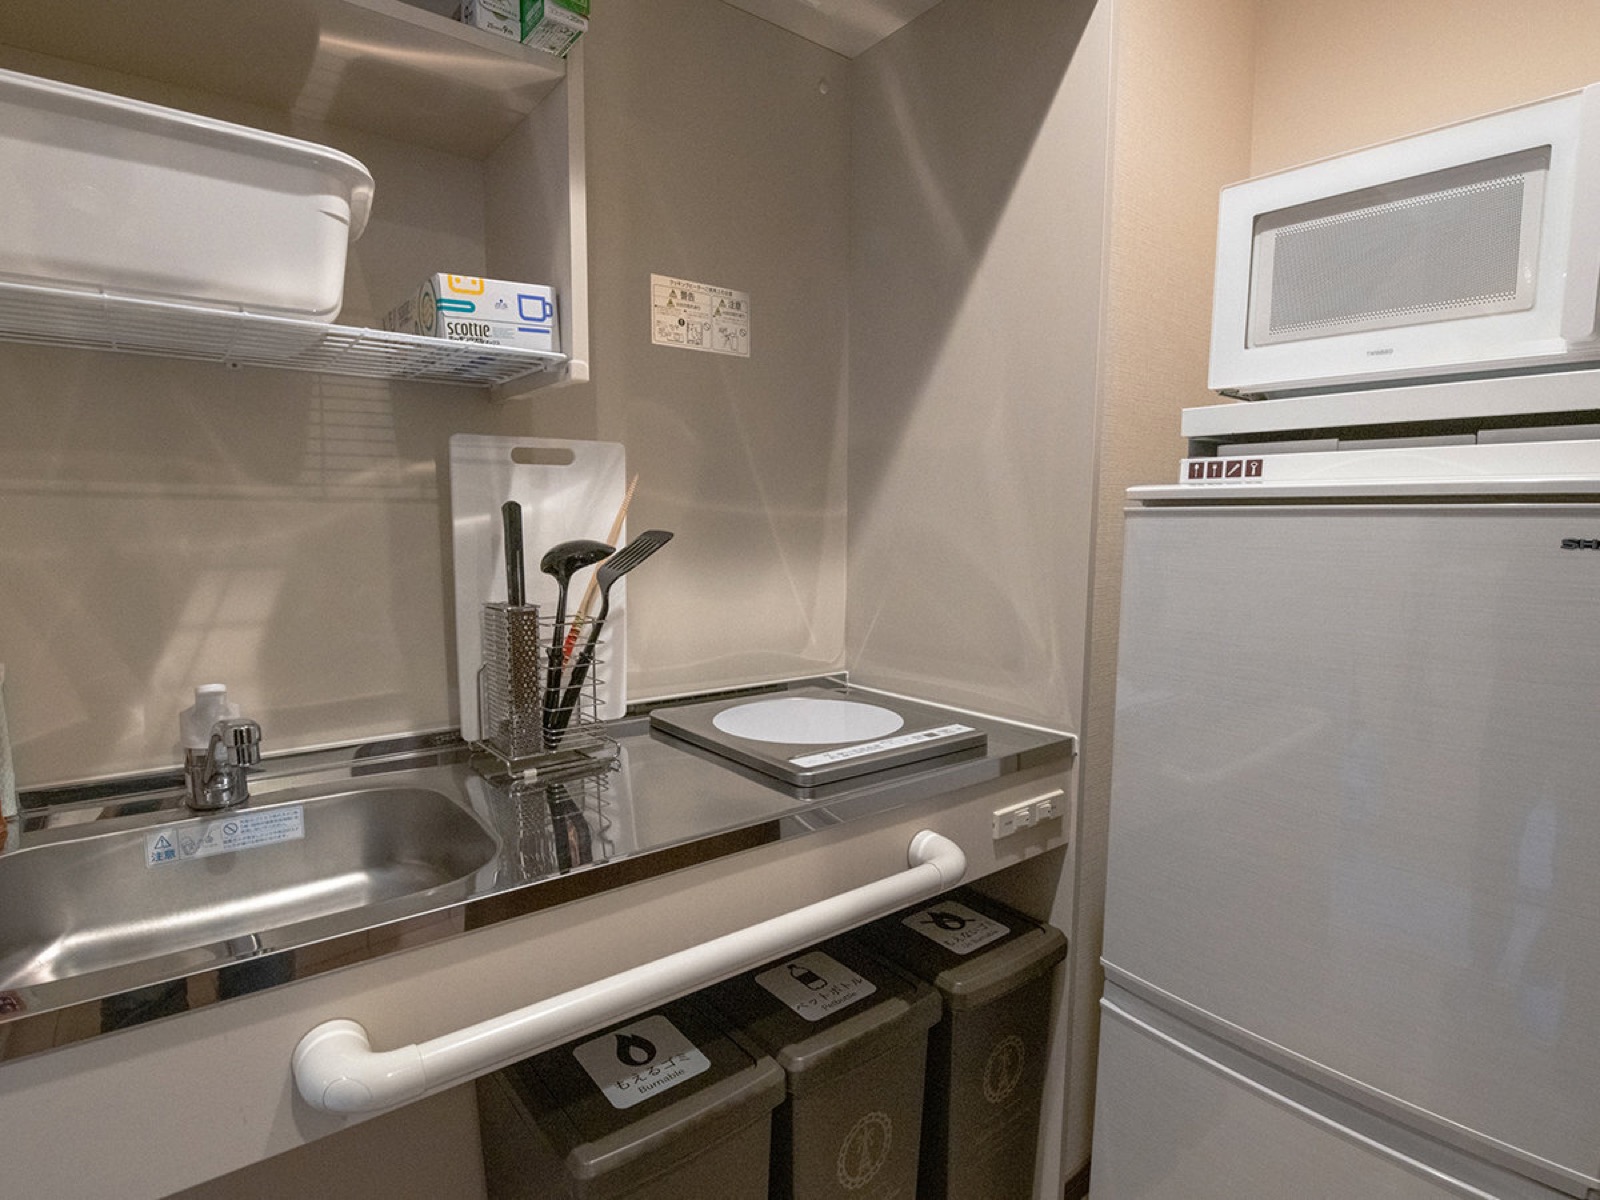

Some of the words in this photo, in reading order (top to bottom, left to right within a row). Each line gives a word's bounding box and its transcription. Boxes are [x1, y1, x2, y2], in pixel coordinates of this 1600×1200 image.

[447, 321, 491, 338] scottie
[1560, 539, 1600, 550] SH
[151, 849, 176, 862] 注意
[616, 1053, 691, 1090] もえるゴミ
[638, 1069, 685, 1094] Burnable
